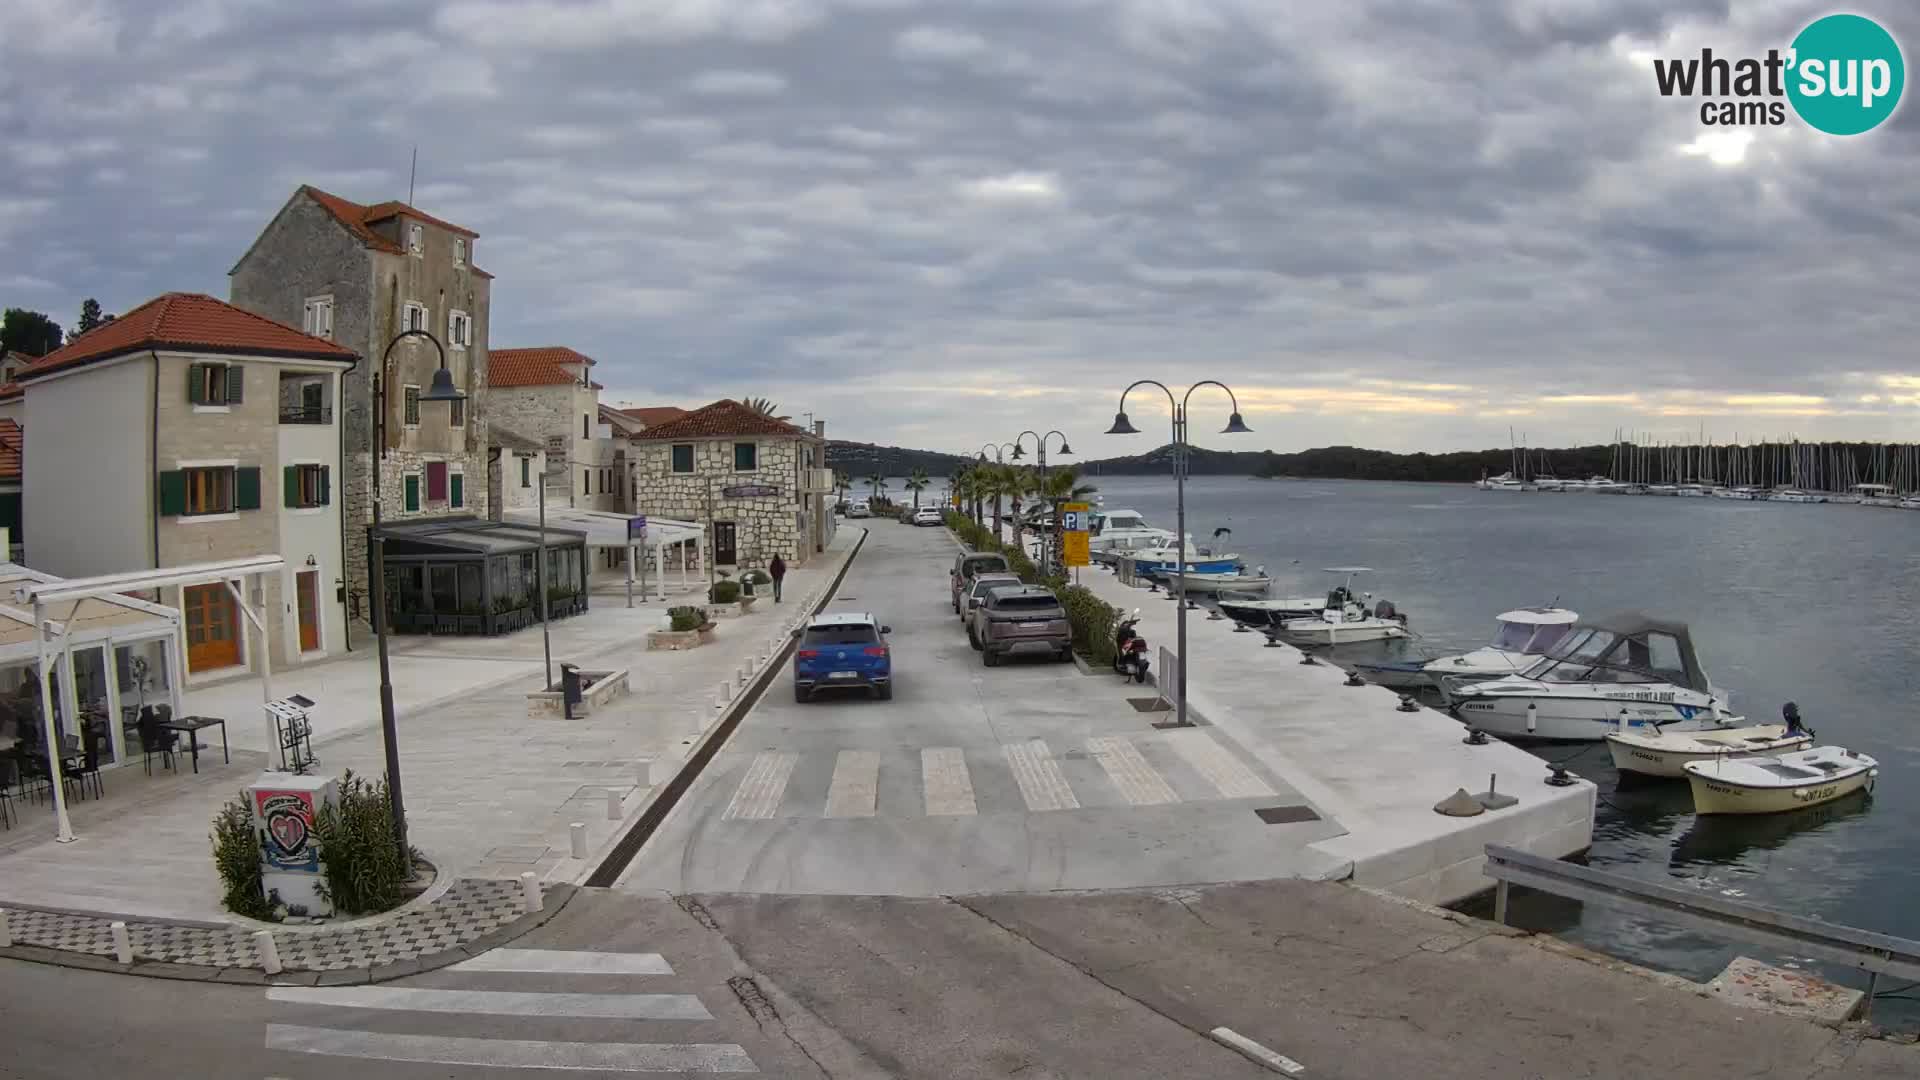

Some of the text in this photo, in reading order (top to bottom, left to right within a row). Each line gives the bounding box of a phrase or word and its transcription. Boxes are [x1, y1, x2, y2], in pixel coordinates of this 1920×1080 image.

[1065, 513, 1076, 529] P
[1636, 692, 1652, 701] RENT
[1659, 692, 1676, 702] BOAT
